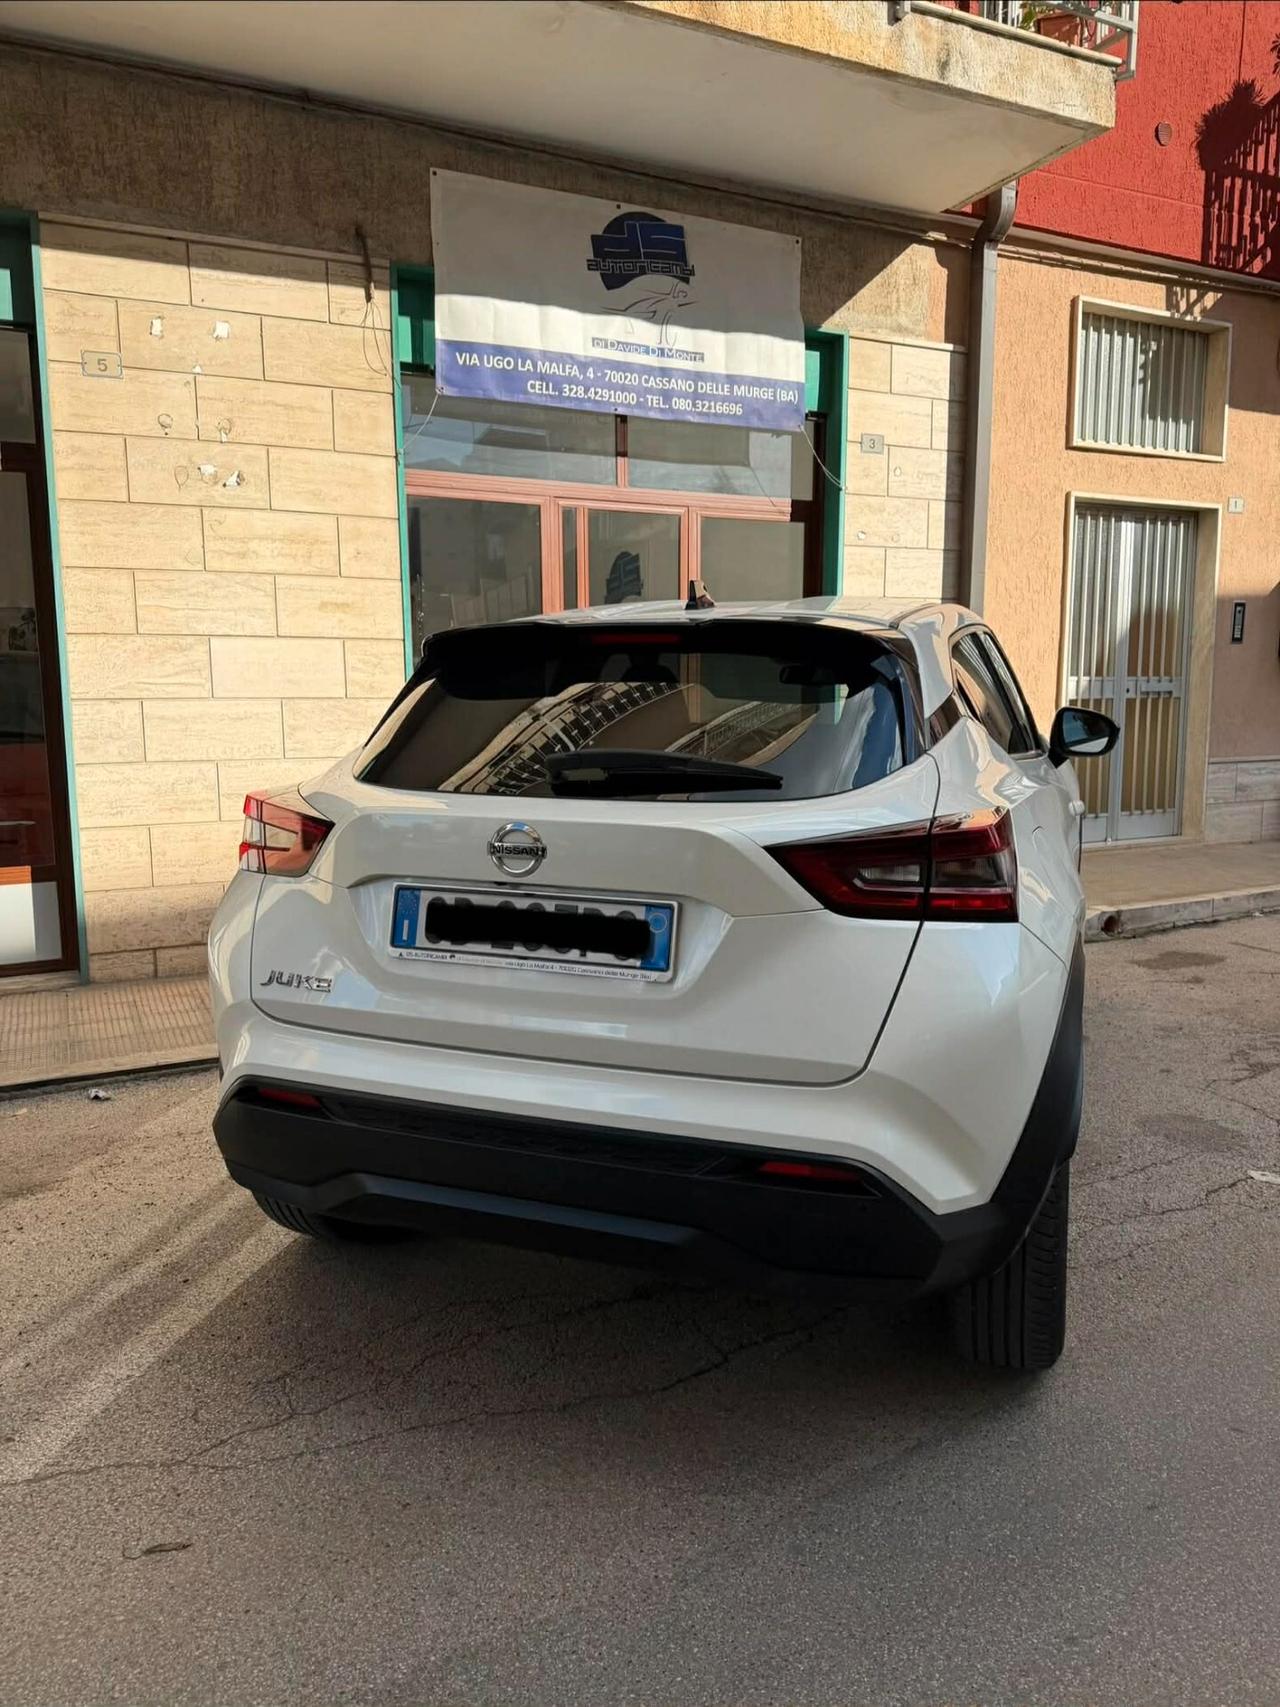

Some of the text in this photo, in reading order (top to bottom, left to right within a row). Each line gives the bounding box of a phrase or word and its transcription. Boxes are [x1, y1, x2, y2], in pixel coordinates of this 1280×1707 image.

[97, 358, 108, 372] 5
[456, 352, 480, 367] VIA
[484, 354, 514, 370] UGO
[518, 358, 534, 372] LA
[537, 361, 584, 380] MALFA,
[587, 367, 594, 380] 4
[605, 370, 639, 386] 70020
[641, 376, 695, 393] CASSANO
[698, 382, 731, 396] DELLE
[733, 385, 774, 401] MURGE
[776, 388, 799, 404] (BA)
[527, 380, 559, 395] CELL.
[562, 384, 637, 405] 328.4291000
[647, 394, 669, 409] TEL.
[672, 397, 743, 416] 080.3216696
[869, 438, 876, 450] 3
[495, 844, 540, 857] NISSAN
[260, 970, 333, 992] JUKE
